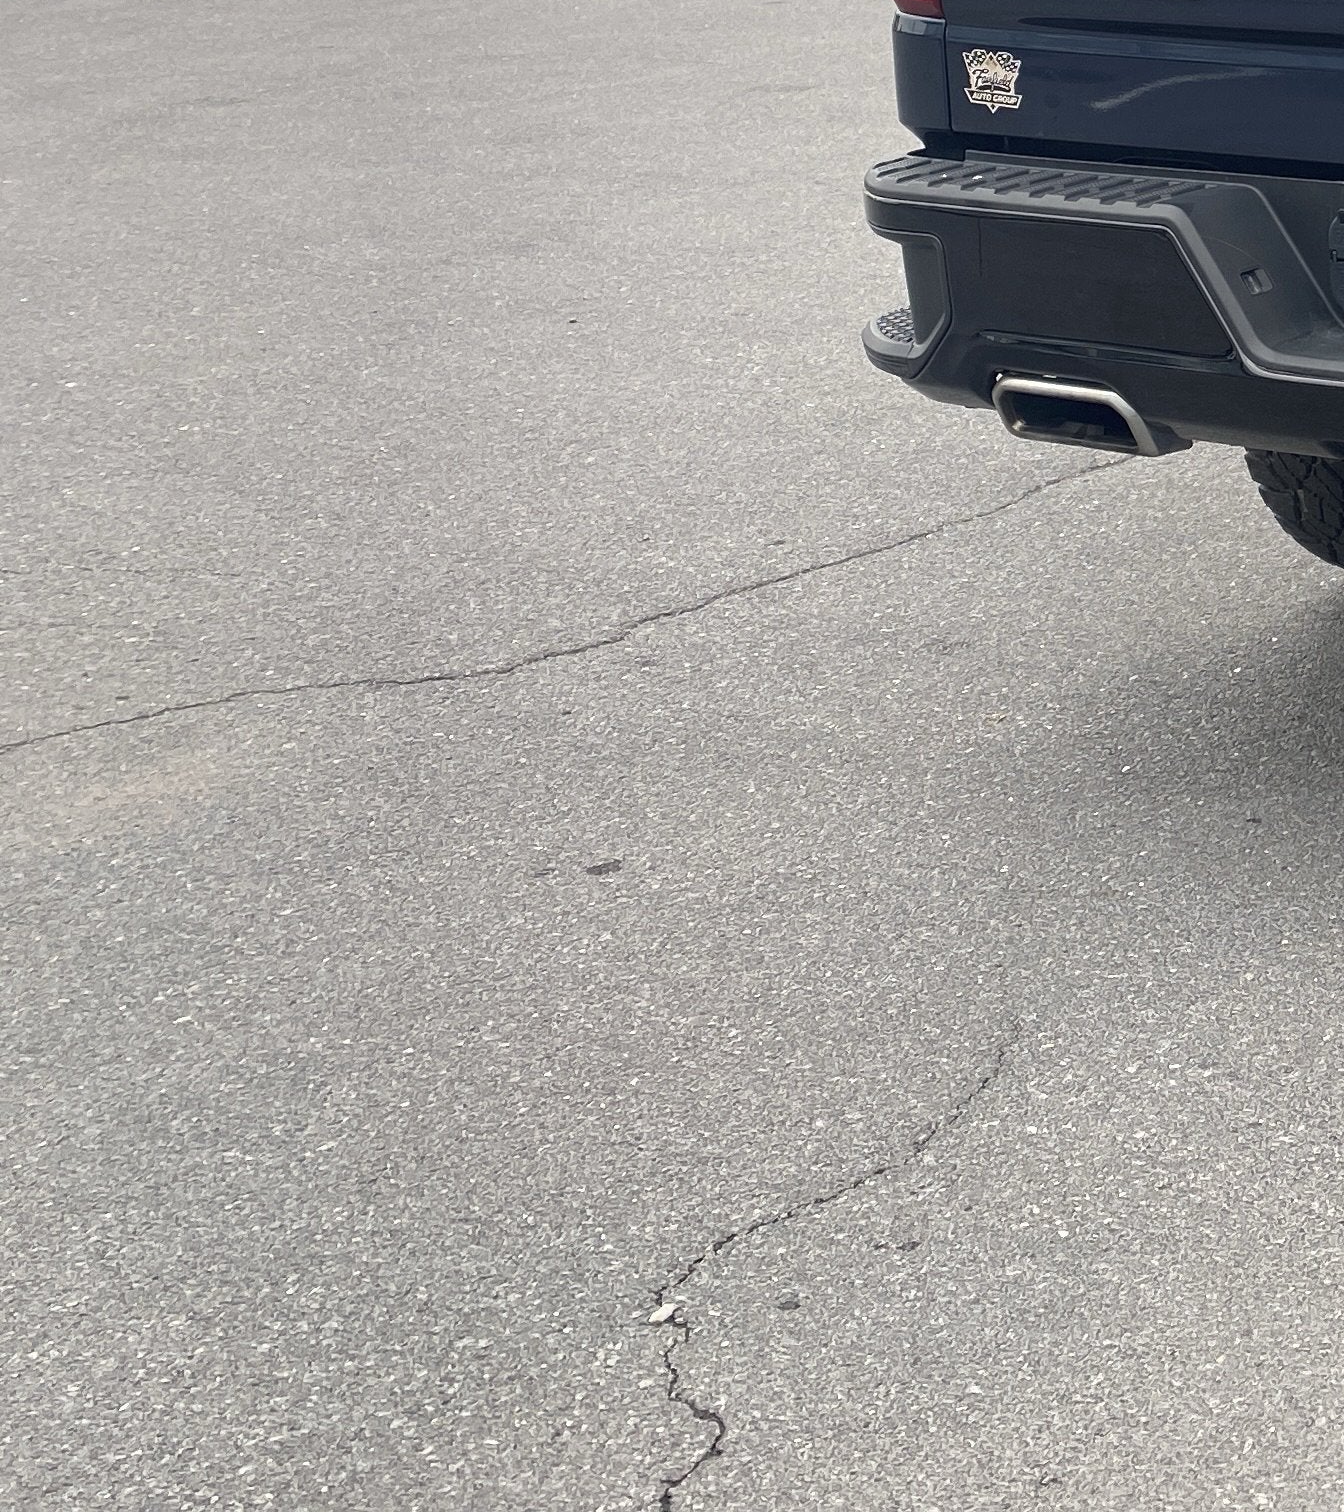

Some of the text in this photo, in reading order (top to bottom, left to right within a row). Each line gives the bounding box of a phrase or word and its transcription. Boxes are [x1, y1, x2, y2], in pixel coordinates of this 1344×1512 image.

[972, 68, 1014, 88] Fairfield
[972, 91, 1018, 104] AUTO GROUP
